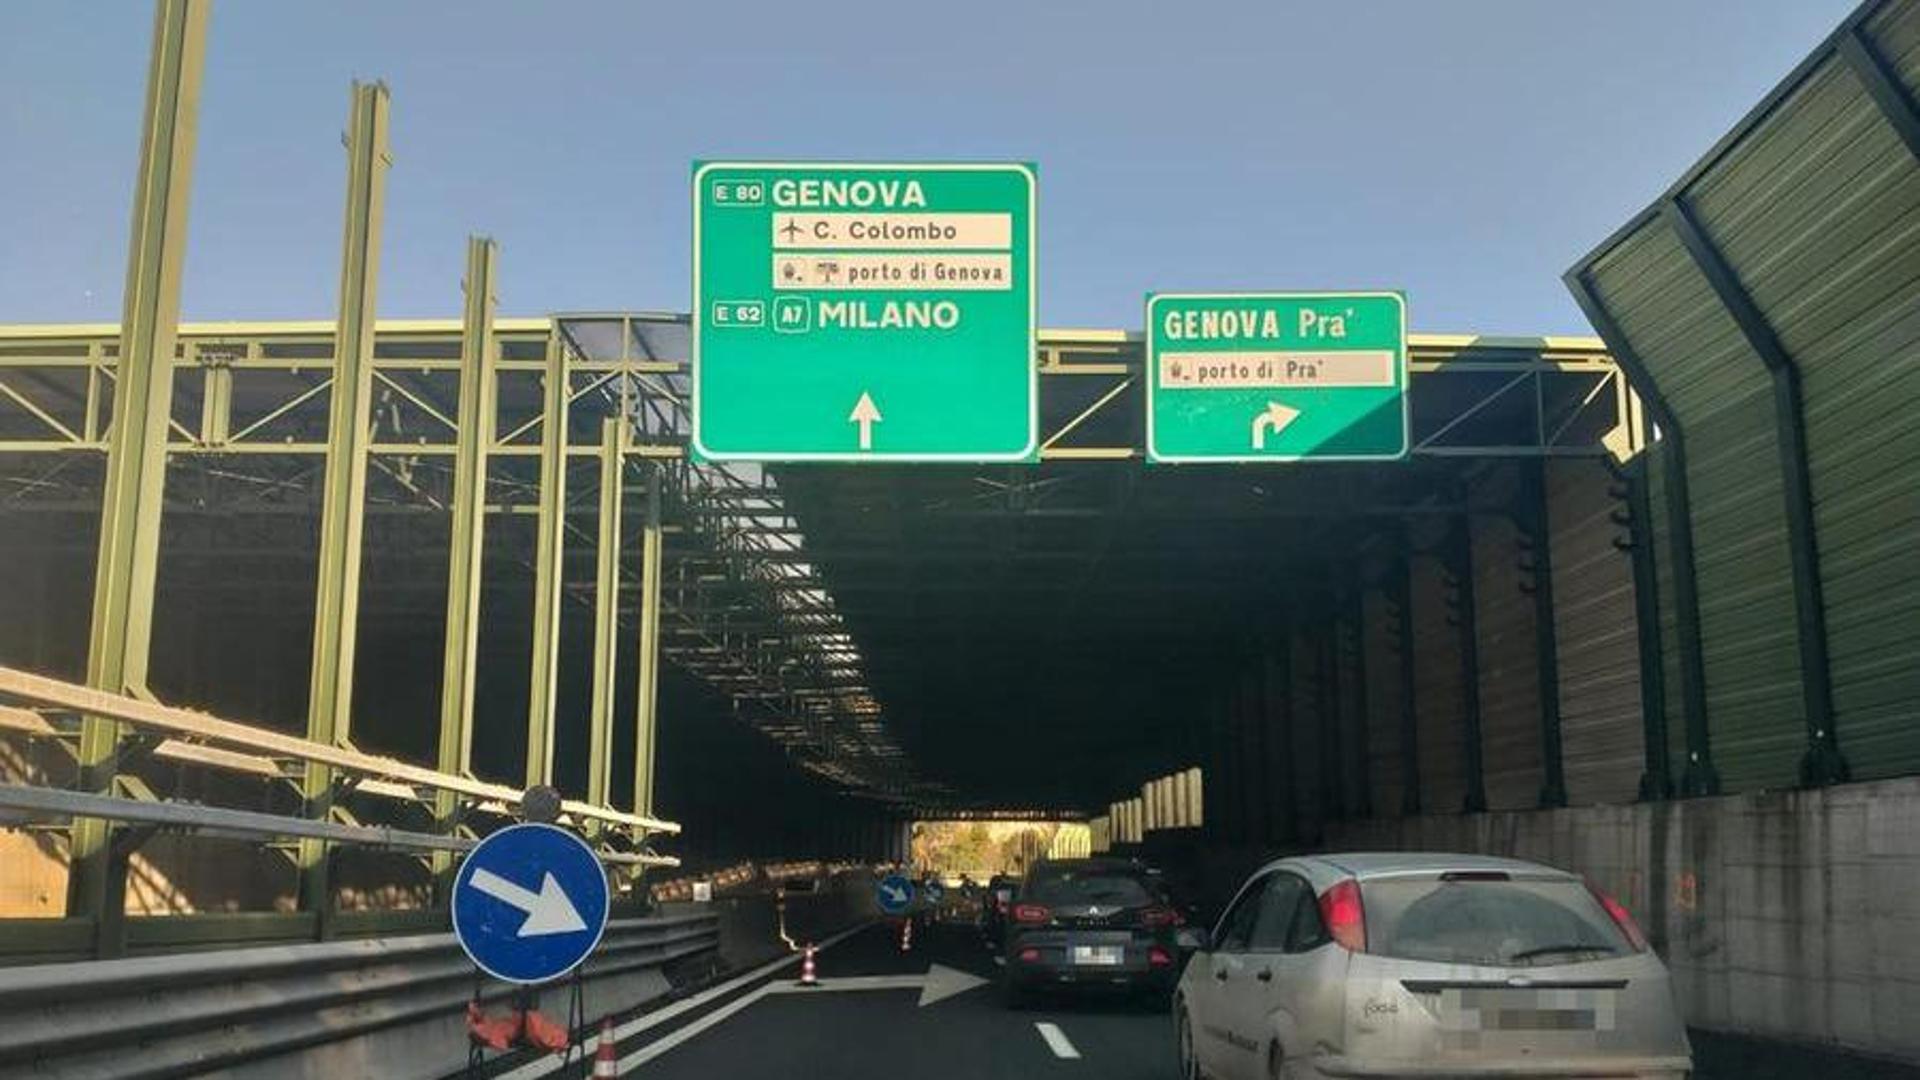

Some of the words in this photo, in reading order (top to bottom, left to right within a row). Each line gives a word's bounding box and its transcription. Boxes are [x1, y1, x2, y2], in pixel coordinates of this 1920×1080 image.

[716, 186, 728, 200] E
[736, 186, 760, 200] 80
[773, 180, 926, 207] GENOVA
[814, 222, 837, 239] C.
[849, 221, 957, 239] Colombo
[849, 264, 901, 283] porto
[910, 262, 926, 281] di
[935, 263, 1002, 281] Genova
[716, 308, 728, 321] E
[736, 308, 761, 322] 62
[782, 307, 802, 323] A7
[819, 302, 959, 328] MILANO
[1164, 310, 1279, 339] GENOVA
[1198, 363, 1248, 382] porto
[1257, 361, 1272, 378] di
